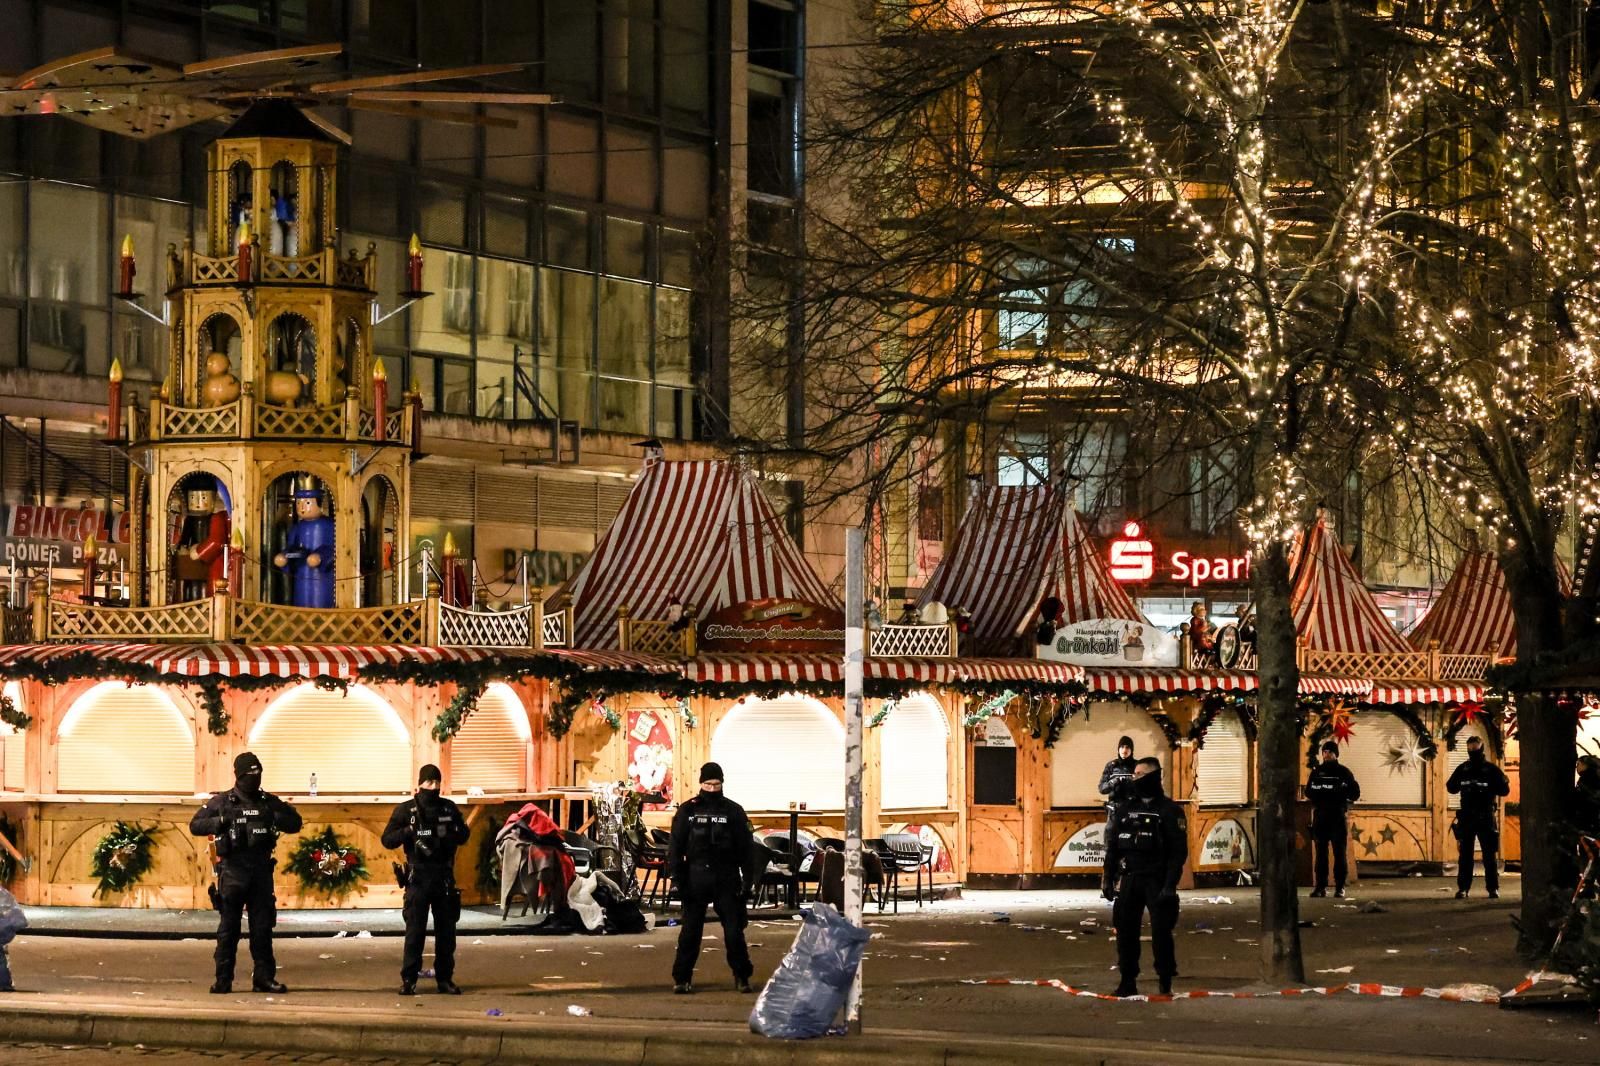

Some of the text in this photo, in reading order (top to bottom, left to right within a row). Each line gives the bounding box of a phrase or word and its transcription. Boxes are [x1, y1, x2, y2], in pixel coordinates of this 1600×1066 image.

[5, 540, 118, 565] DÖNER PZA
[1056, 636, 1120, 655] Grünkohl
